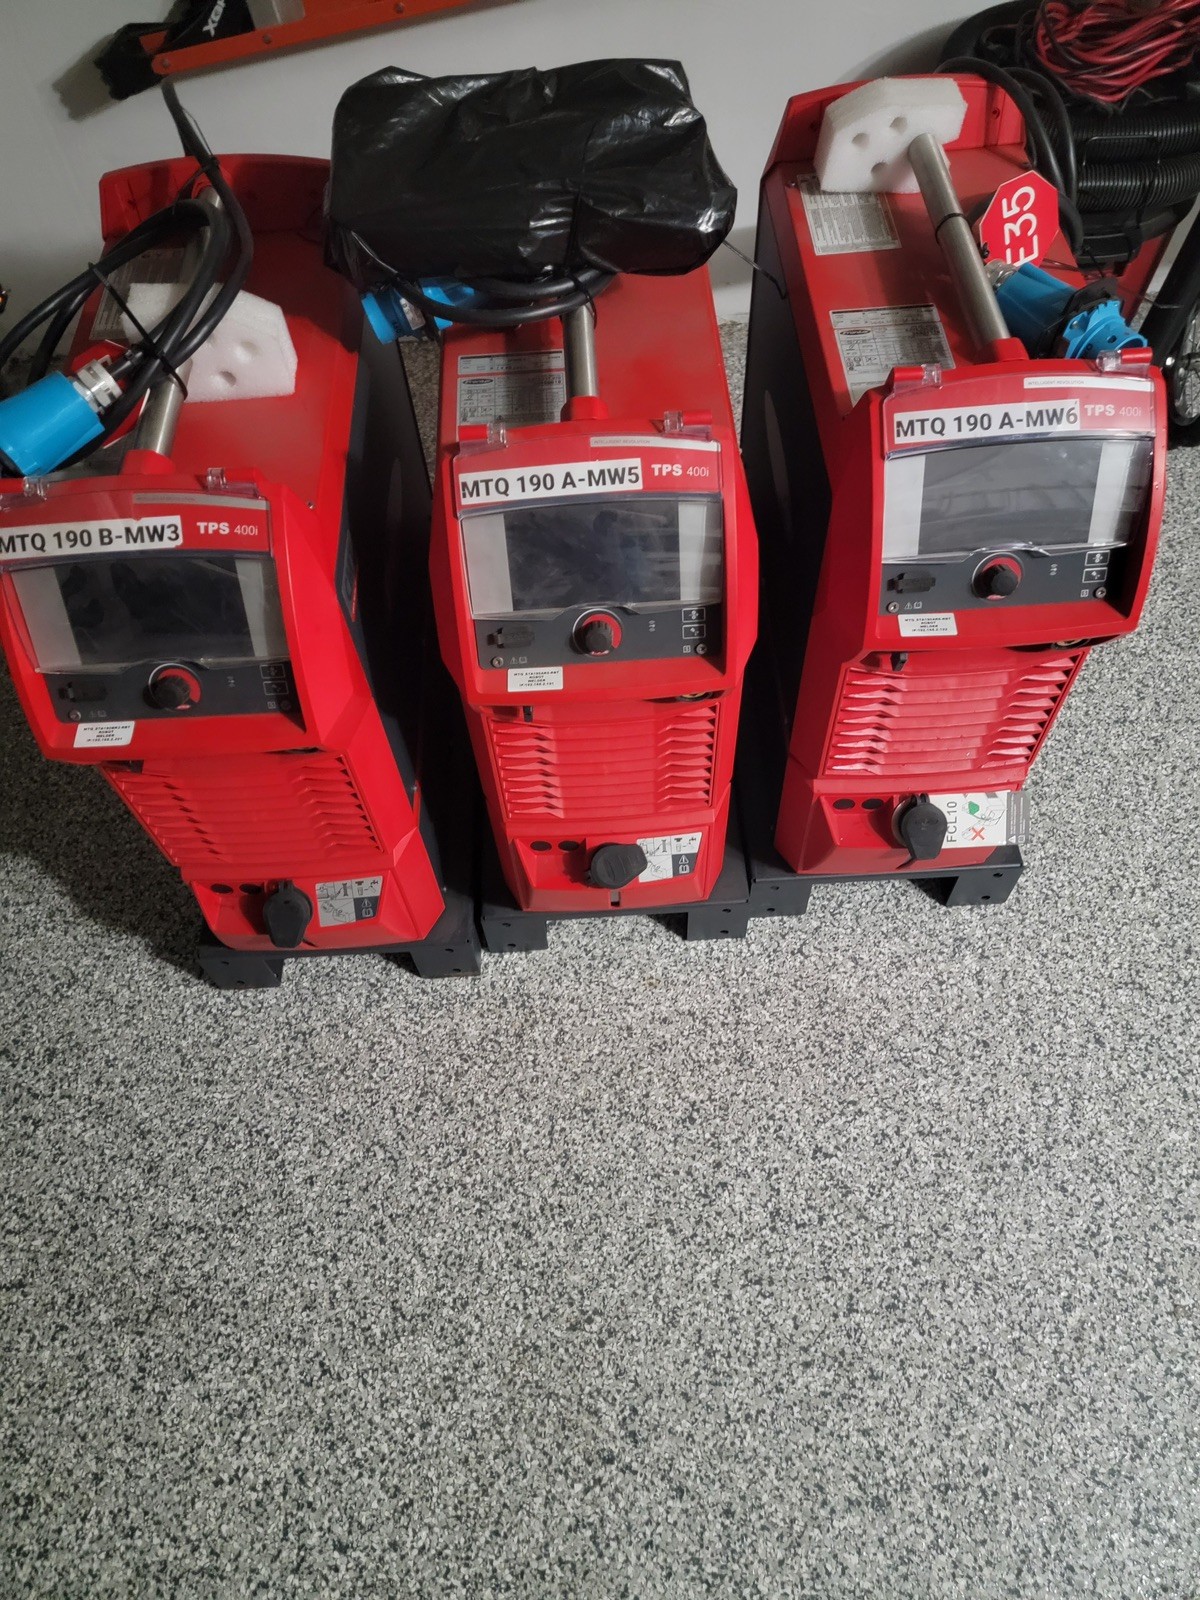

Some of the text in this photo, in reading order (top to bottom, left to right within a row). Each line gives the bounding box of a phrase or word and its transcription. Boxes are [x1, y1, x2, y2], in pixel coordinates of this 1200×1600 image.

[1002, 186, 1038, 267] E35
[896, 407, 1078, 437] MTQ 190 A-MW6
[1084, 404, 1141, 416] TPS 400i
[461, 466, 640, 498] MTQ 190 A-MW5
[651, 464, 709, 477] TPS 400i
[0, 524, 180, 553] MTQ 190 B-MW3
[197, 522, 258, 535] TPS 400i
[946, 801, 957, 842] FCL10
